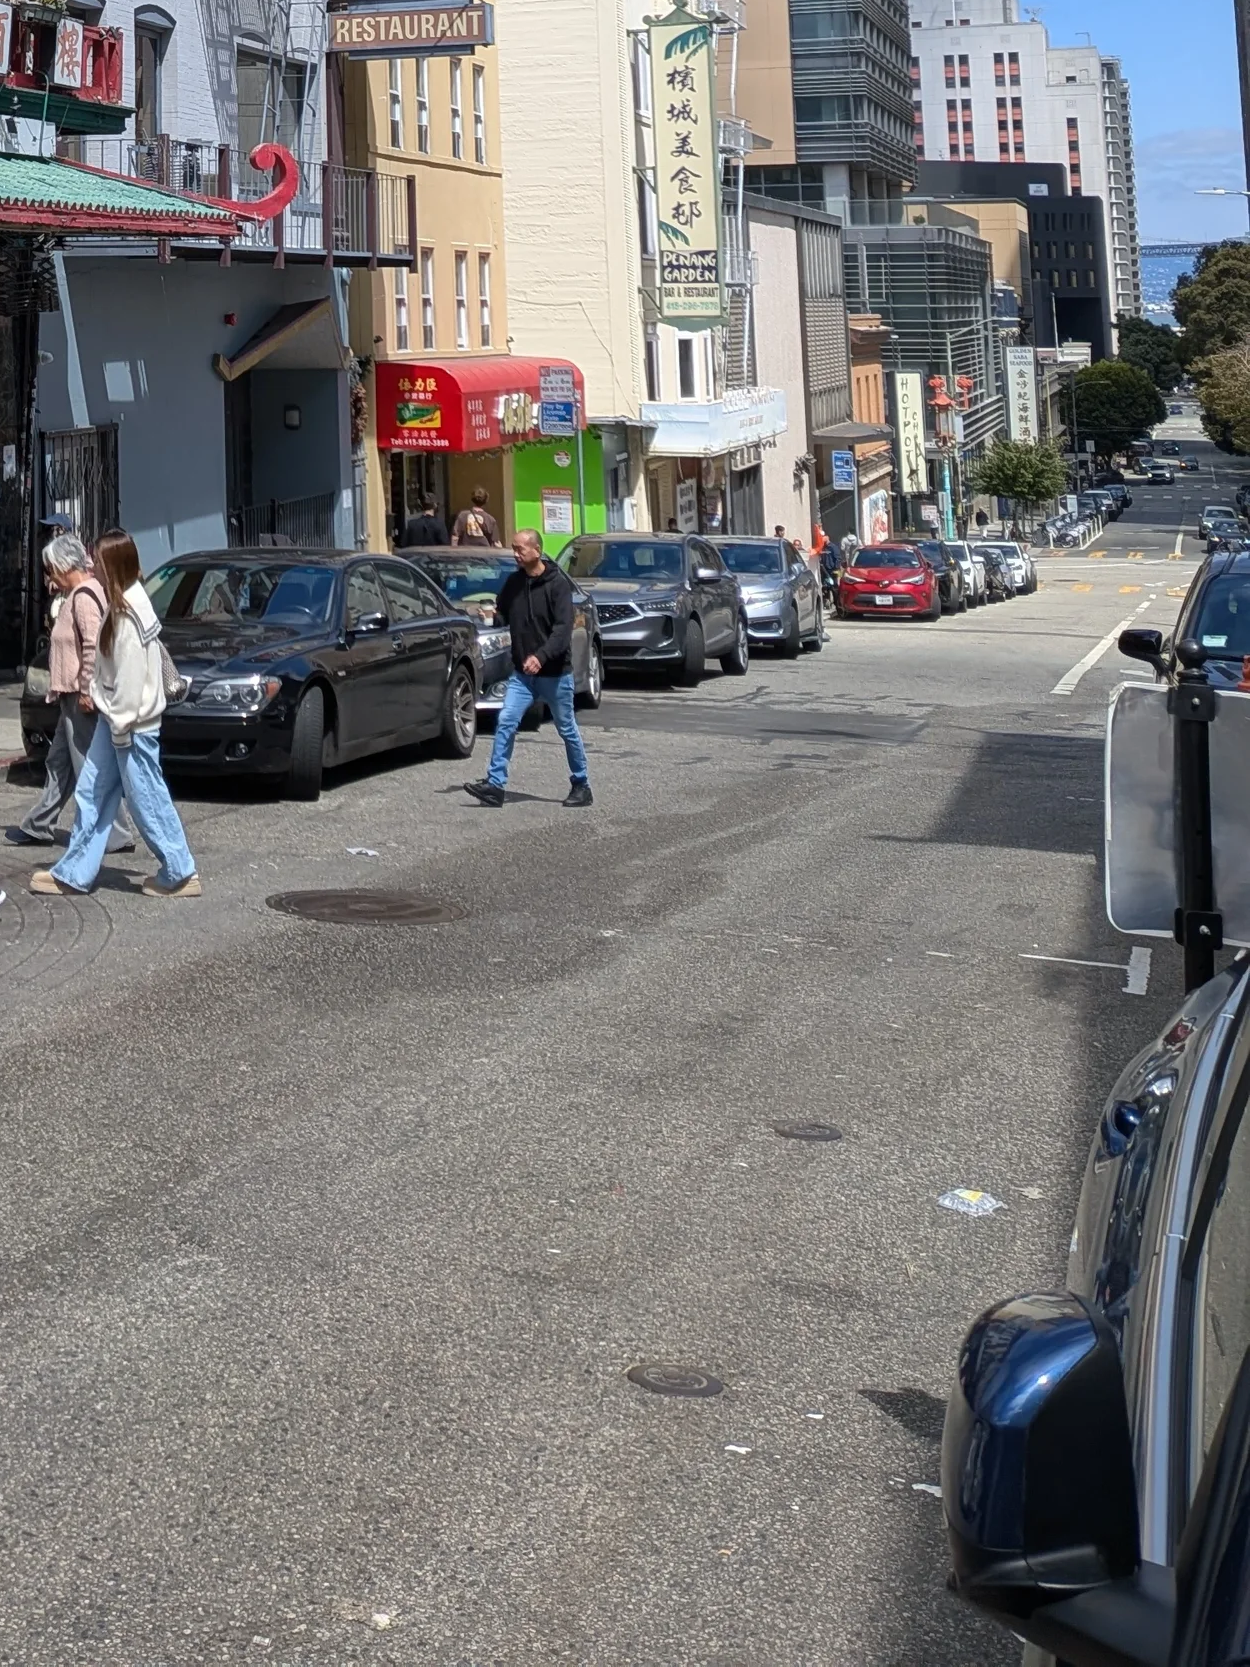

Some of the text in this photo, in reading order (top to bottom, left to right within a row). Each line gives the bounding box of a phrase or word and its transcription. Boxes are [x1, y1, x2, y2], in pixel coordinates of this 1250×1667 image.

[336, 10, 484, 44] RESTAURANT
[663, 251, 717, 267] PENANG
[664, 265, 717, 283] GARDEN
